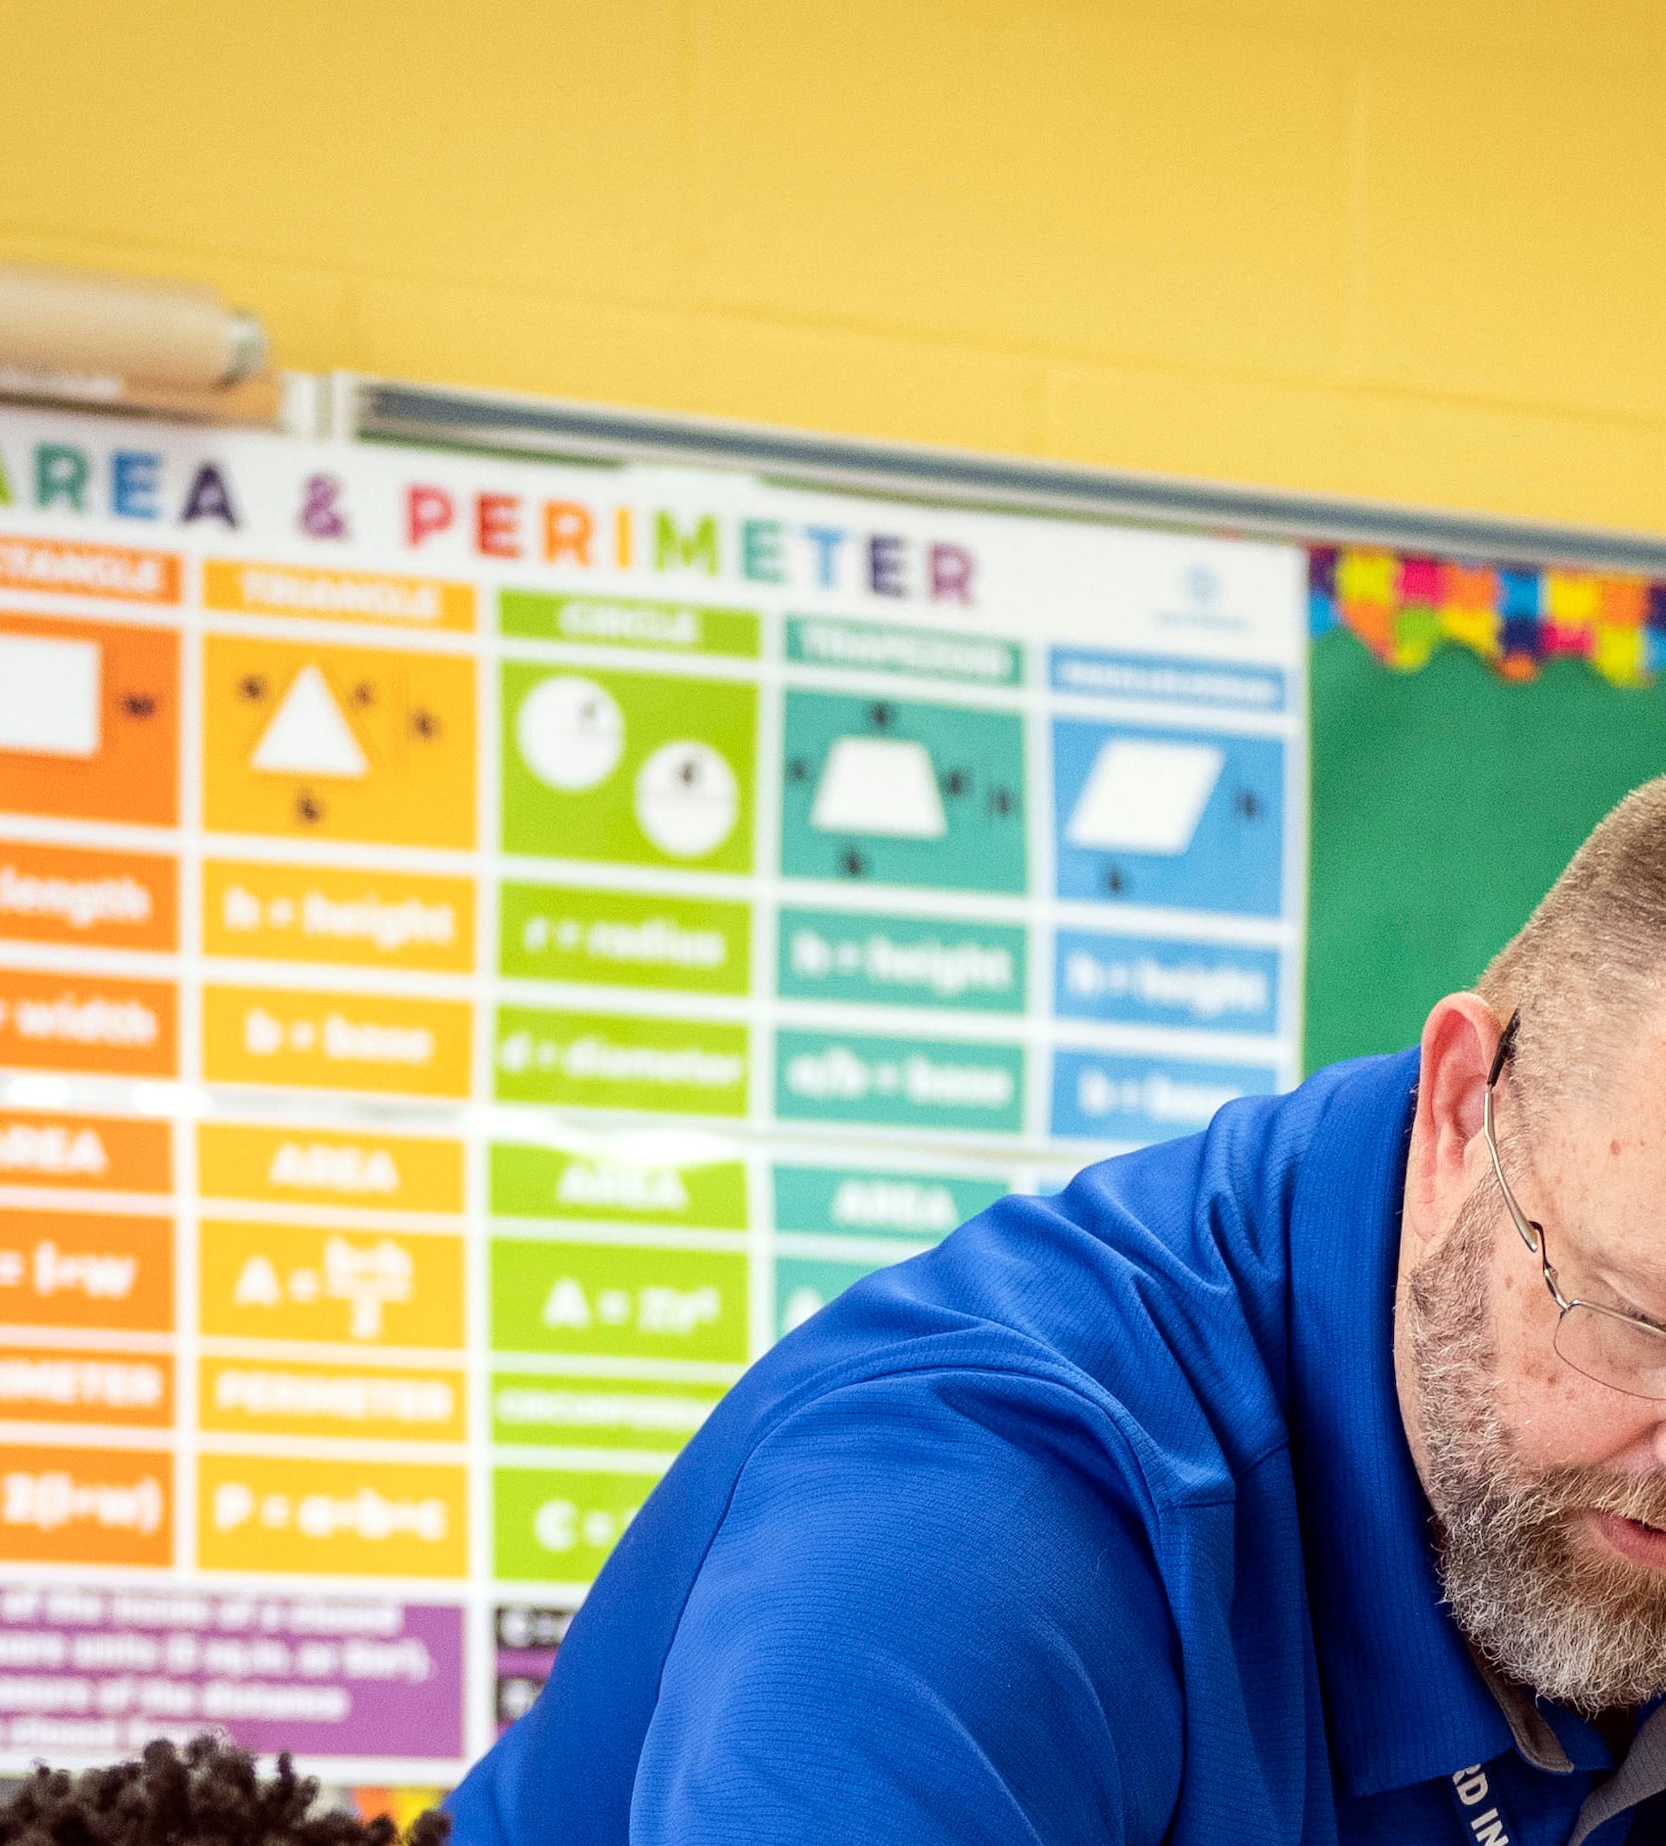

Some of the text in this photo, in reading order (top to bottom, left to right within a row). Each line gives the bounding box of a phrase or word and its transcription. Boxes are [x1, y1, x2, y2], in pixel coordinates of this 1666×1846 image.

[298, 473, 350, 538] &
[403, 484, 978, 605] PERIMETER
[270, 1145, 398, 1193] AREA
[238, 1259, 280, 1305] A
[543, 1280, 590, 1327] A
[217, 1371, 453, 1422] PERIMETER
[214, 1484, 251, 1531] P
